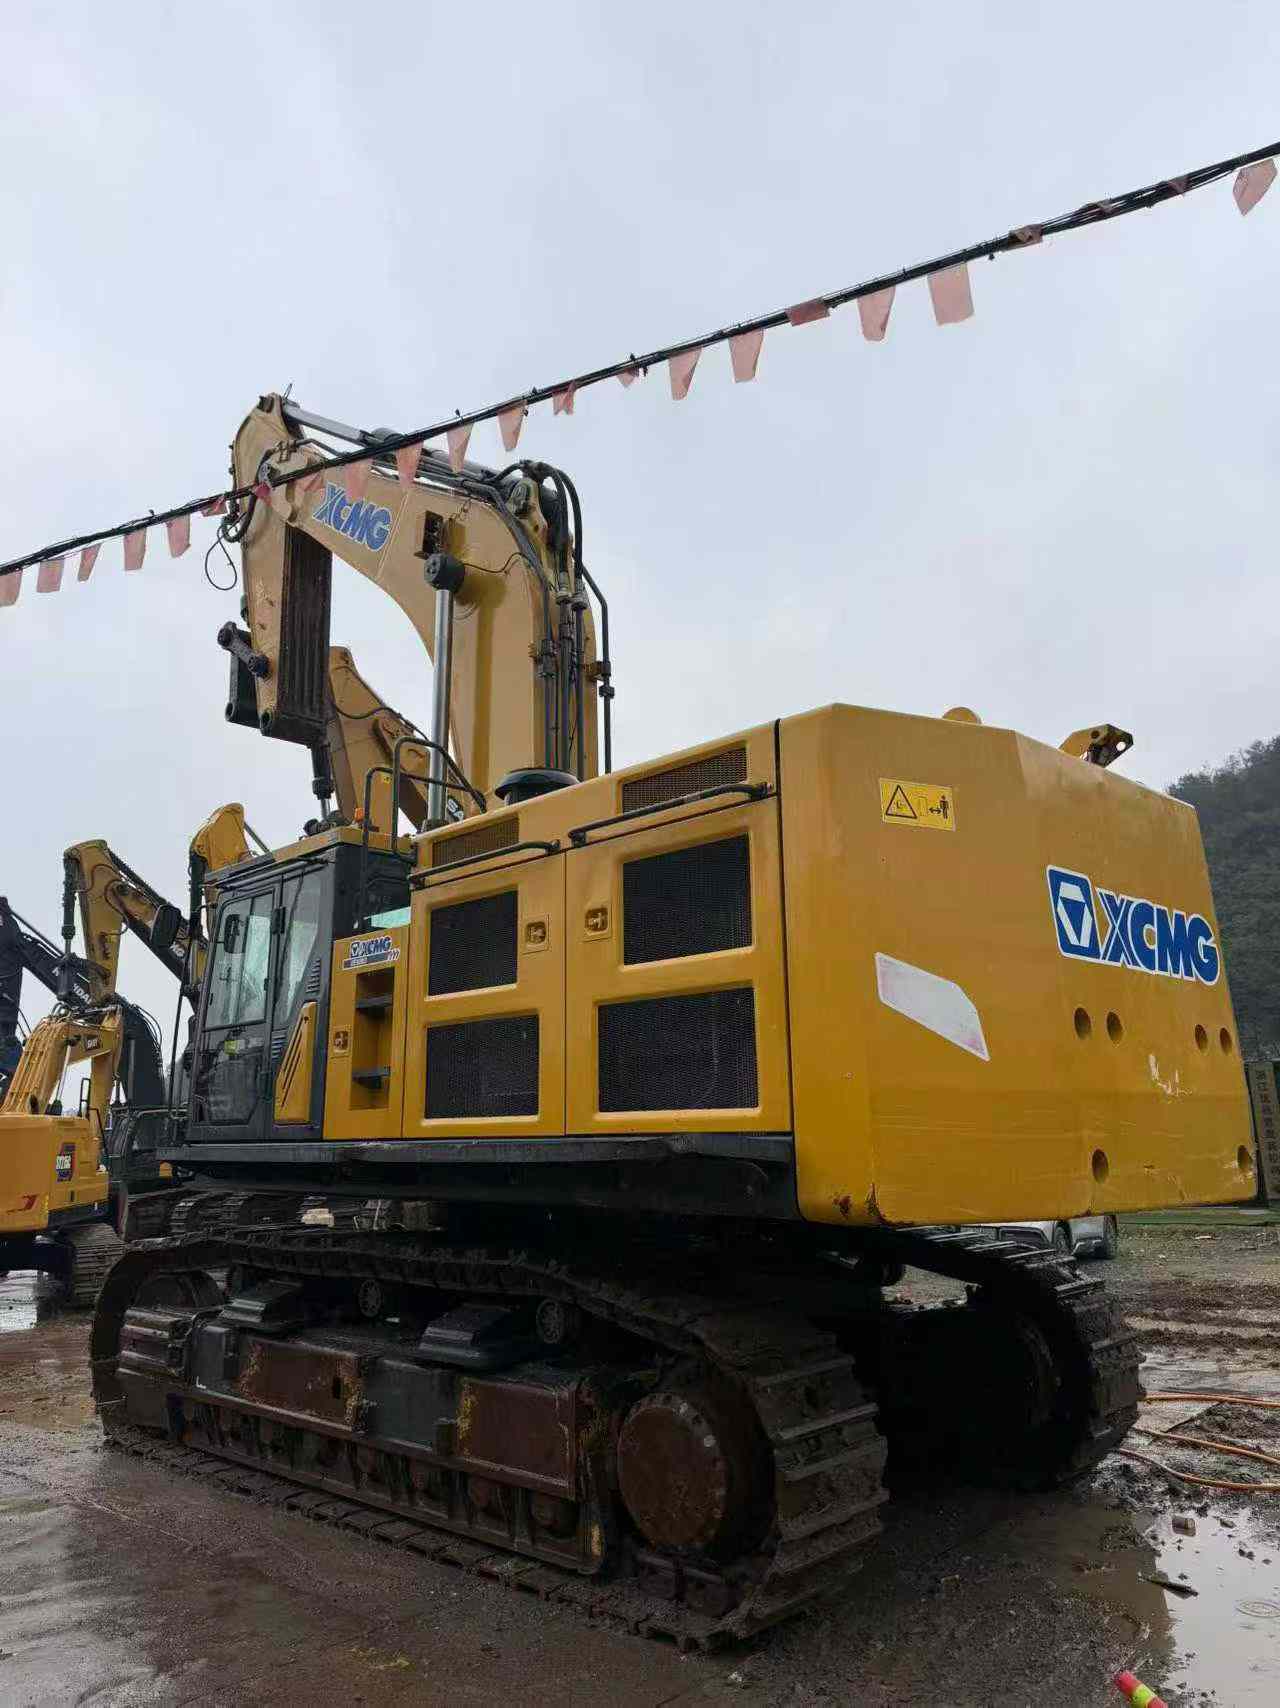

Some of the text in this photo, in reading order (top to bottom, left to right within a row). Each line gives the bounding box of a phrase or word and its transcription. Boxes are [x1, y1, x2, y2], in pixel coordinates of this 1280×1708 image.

[312, 481, 392, 552] XCMG
[360, 935, 392, 957] XCMG
[1096, 887, 1220, 986] XCMG
